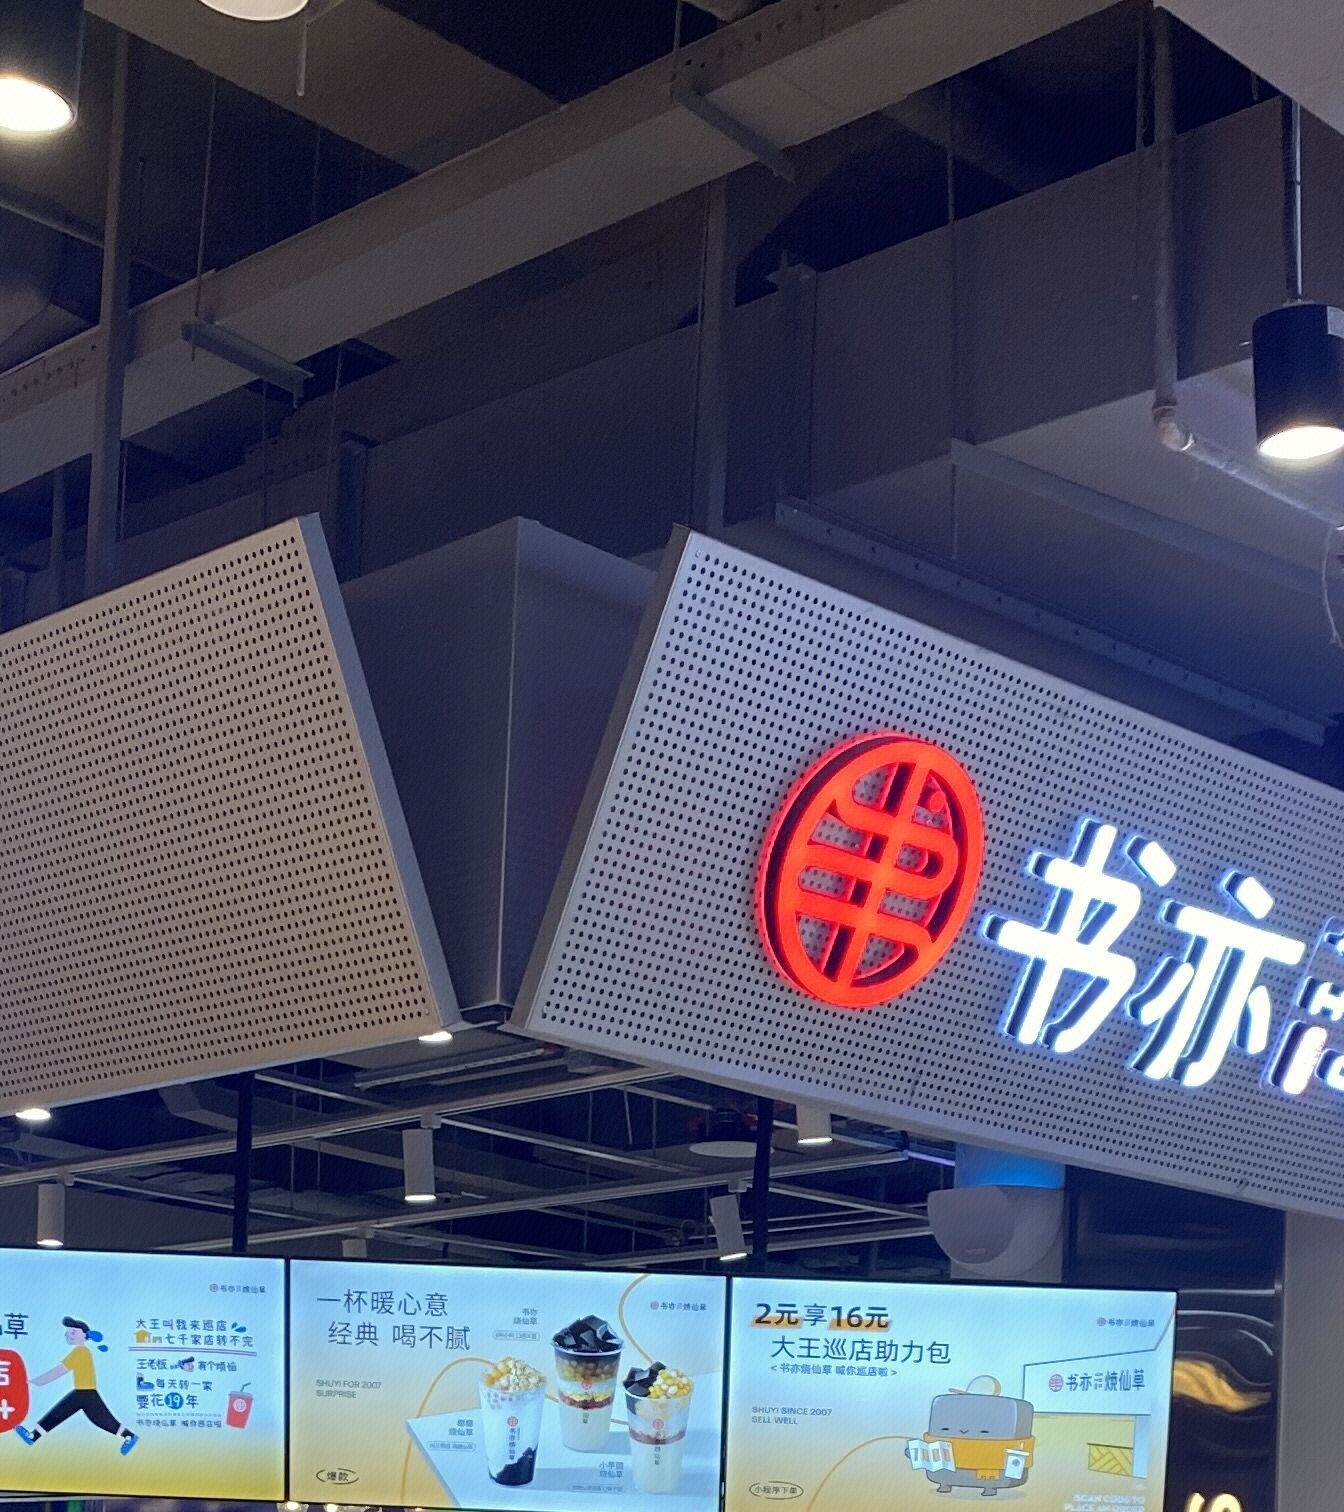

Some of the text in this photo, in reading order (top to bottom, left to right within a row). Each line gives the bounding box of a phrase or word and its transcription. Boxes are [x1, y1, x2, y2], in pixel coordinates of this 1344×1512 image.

[316, 1288, 449, 1318] 一杯暖心意
[754, 1302, 890, 1330] 2元享16元
[327, 1320, 472, 1352] 经典 喝不腻
[771, 1337, 952, 1365] 大王巡店助力包
